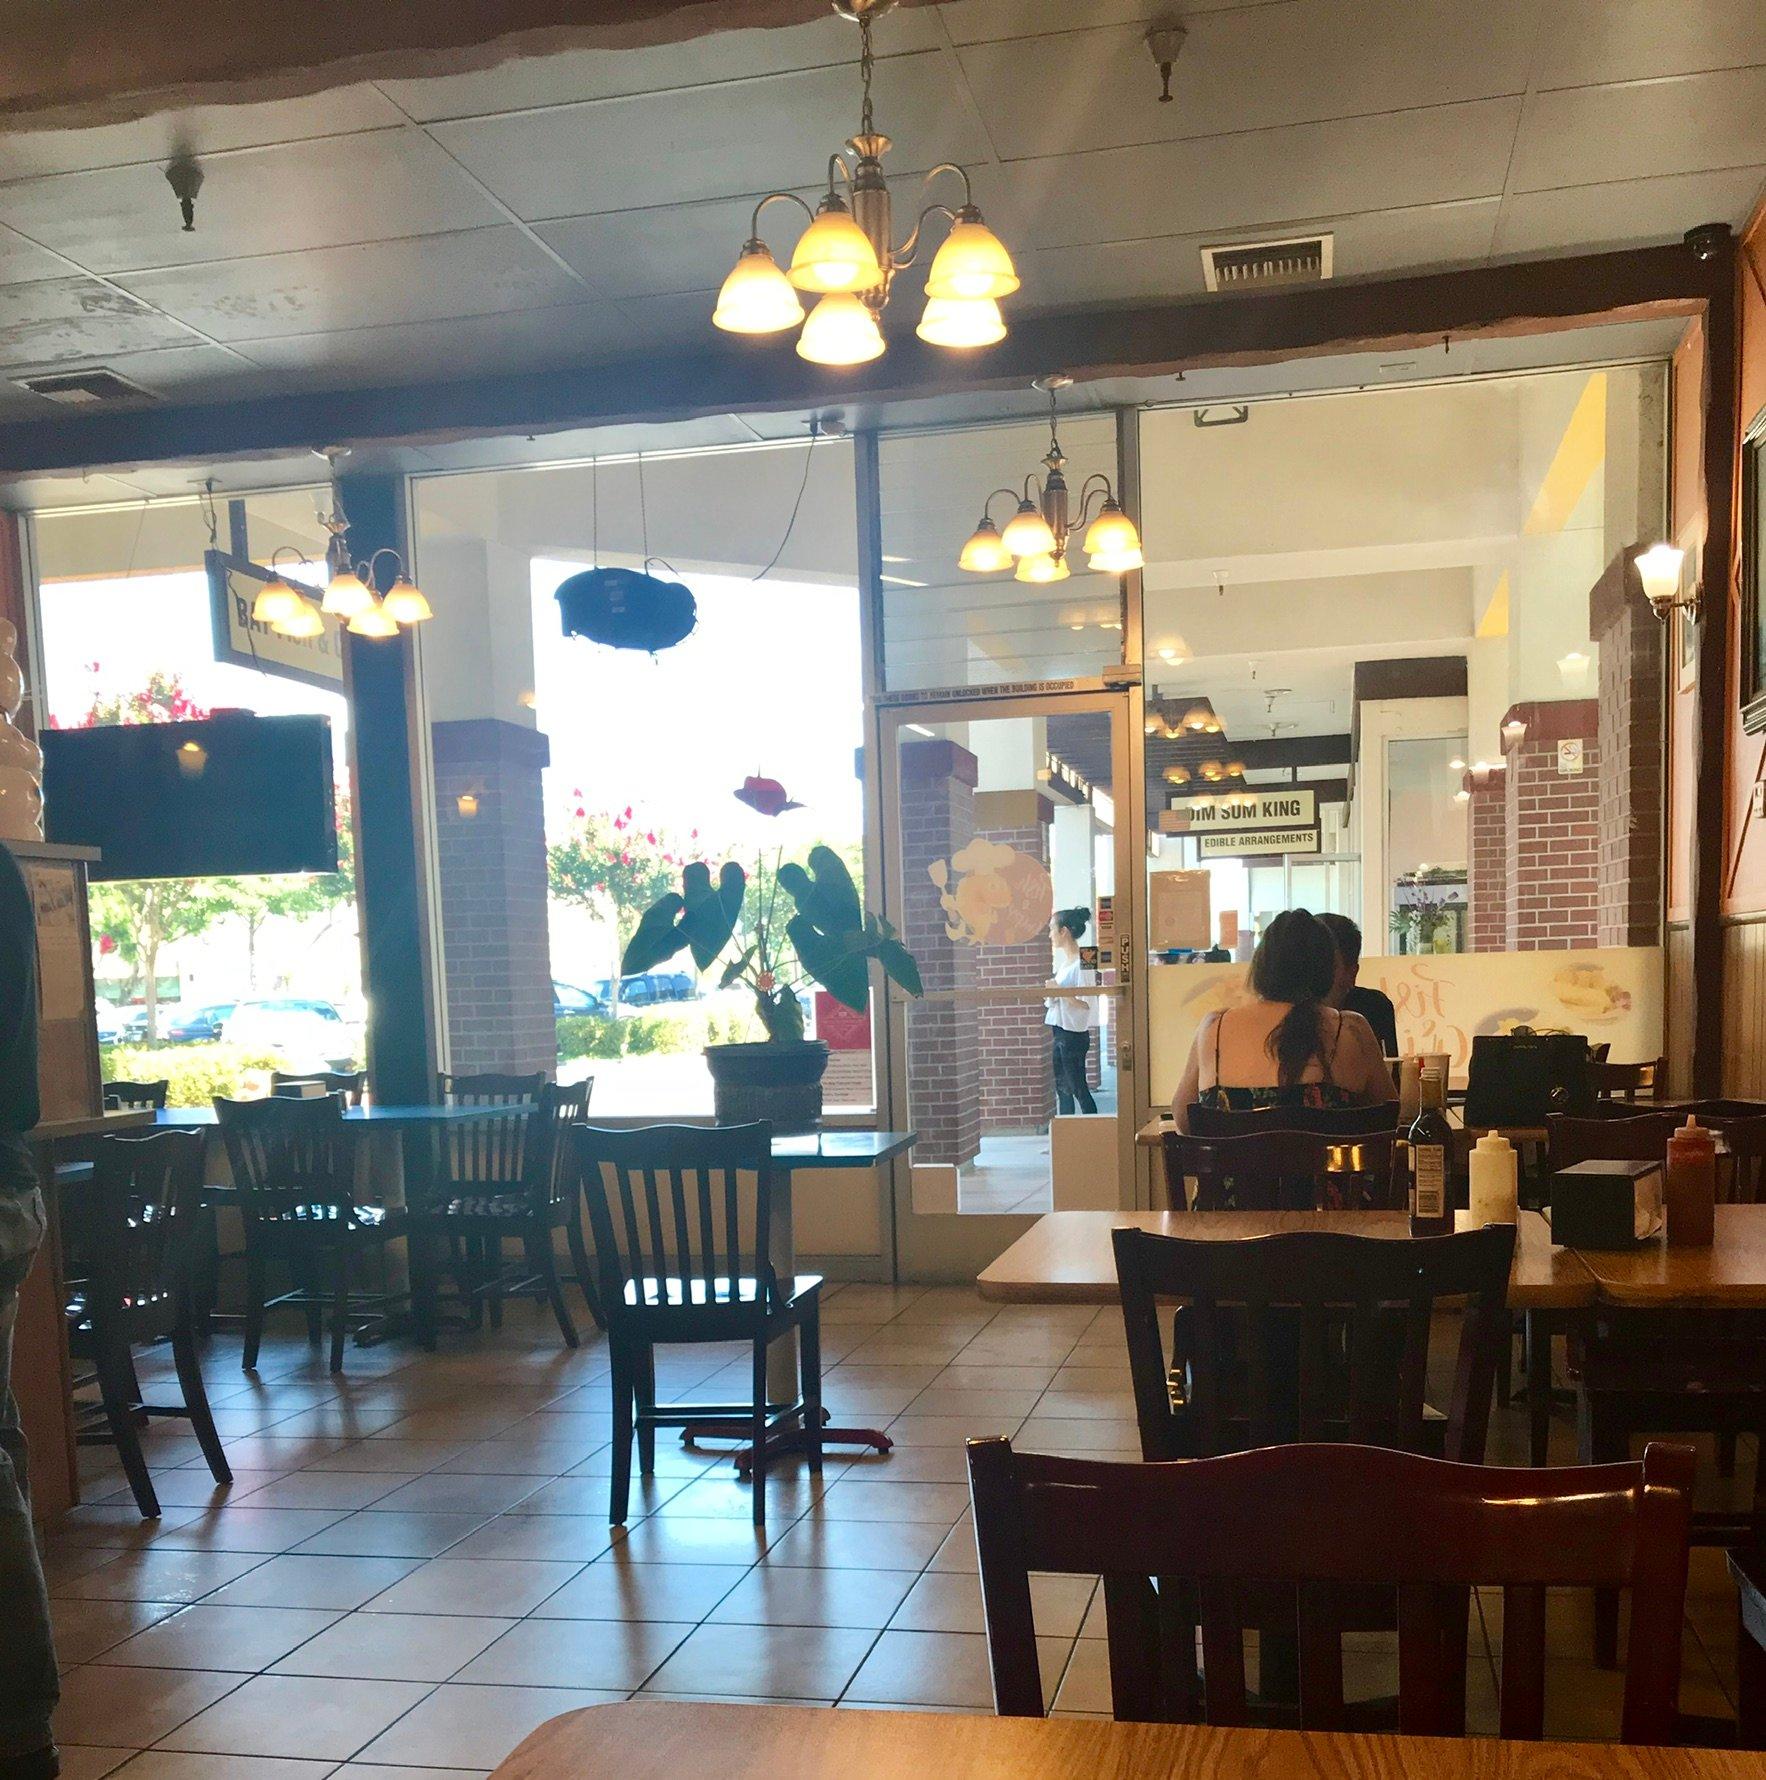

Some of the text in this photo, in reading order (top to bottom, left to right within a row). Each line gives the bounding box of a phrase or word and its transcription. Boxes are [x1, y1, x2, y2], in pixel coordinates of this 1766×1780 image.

[951, 688, 980, 698] UNLOCKED
[981, 686, 999, 695] WHEN
[999, 685, 1011, 694] THE
[1011, 683, 1037, 693] BUILDING
[1038, 682, 1045, 691] IS
[1046, 681, 1074, 690] OCCUPIED
[1220, 802, 1257, 820] SUM
[1262, 799, 1301, 818] KING
[1204, 832, 1314, 848] EDIBLE ARRANGEMENTS
[1121, 937, 1129, 972] PUSH
